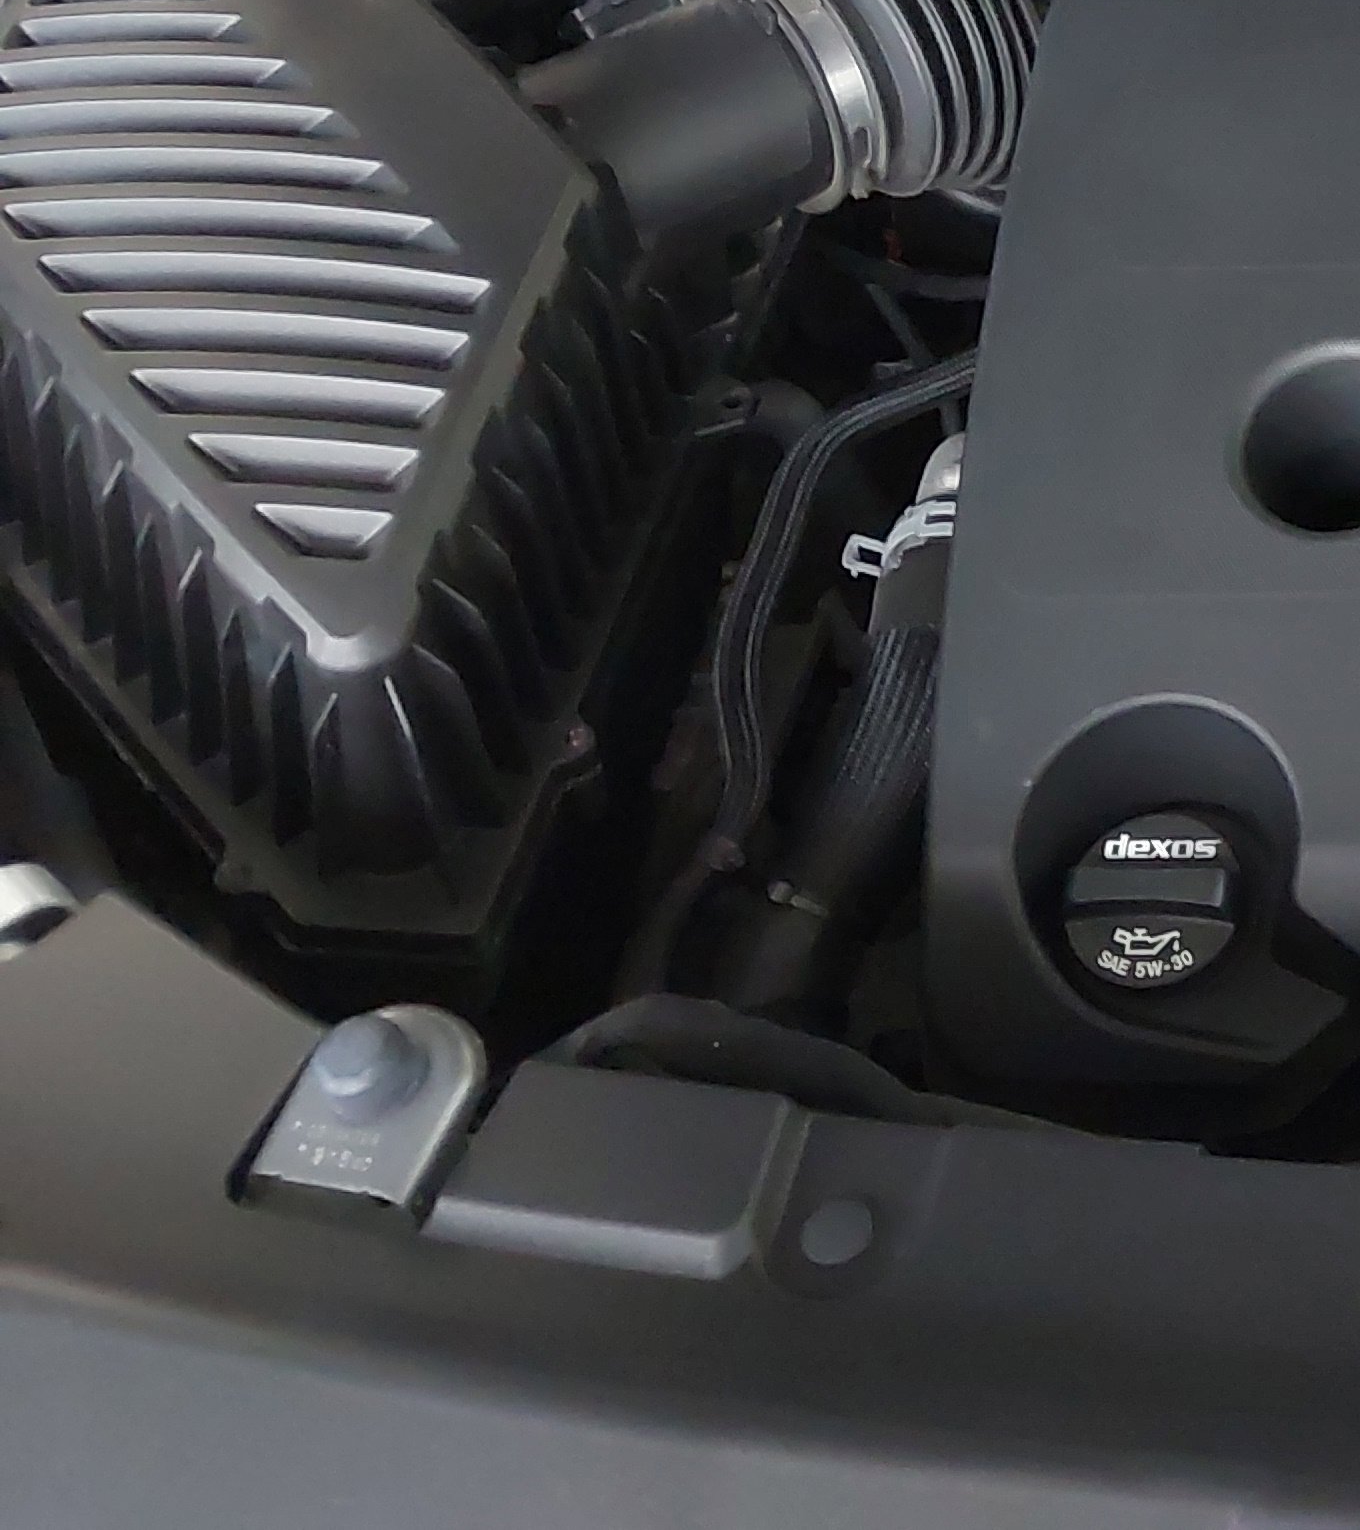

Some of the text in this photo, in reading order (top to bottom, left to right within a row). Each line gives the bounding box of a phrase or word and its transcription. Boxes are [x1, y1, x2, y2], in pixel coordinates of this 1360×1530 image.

[1103, 833, 1223, 860] dexos
[1098, 950, 1194, 979] SAE 5W-30
